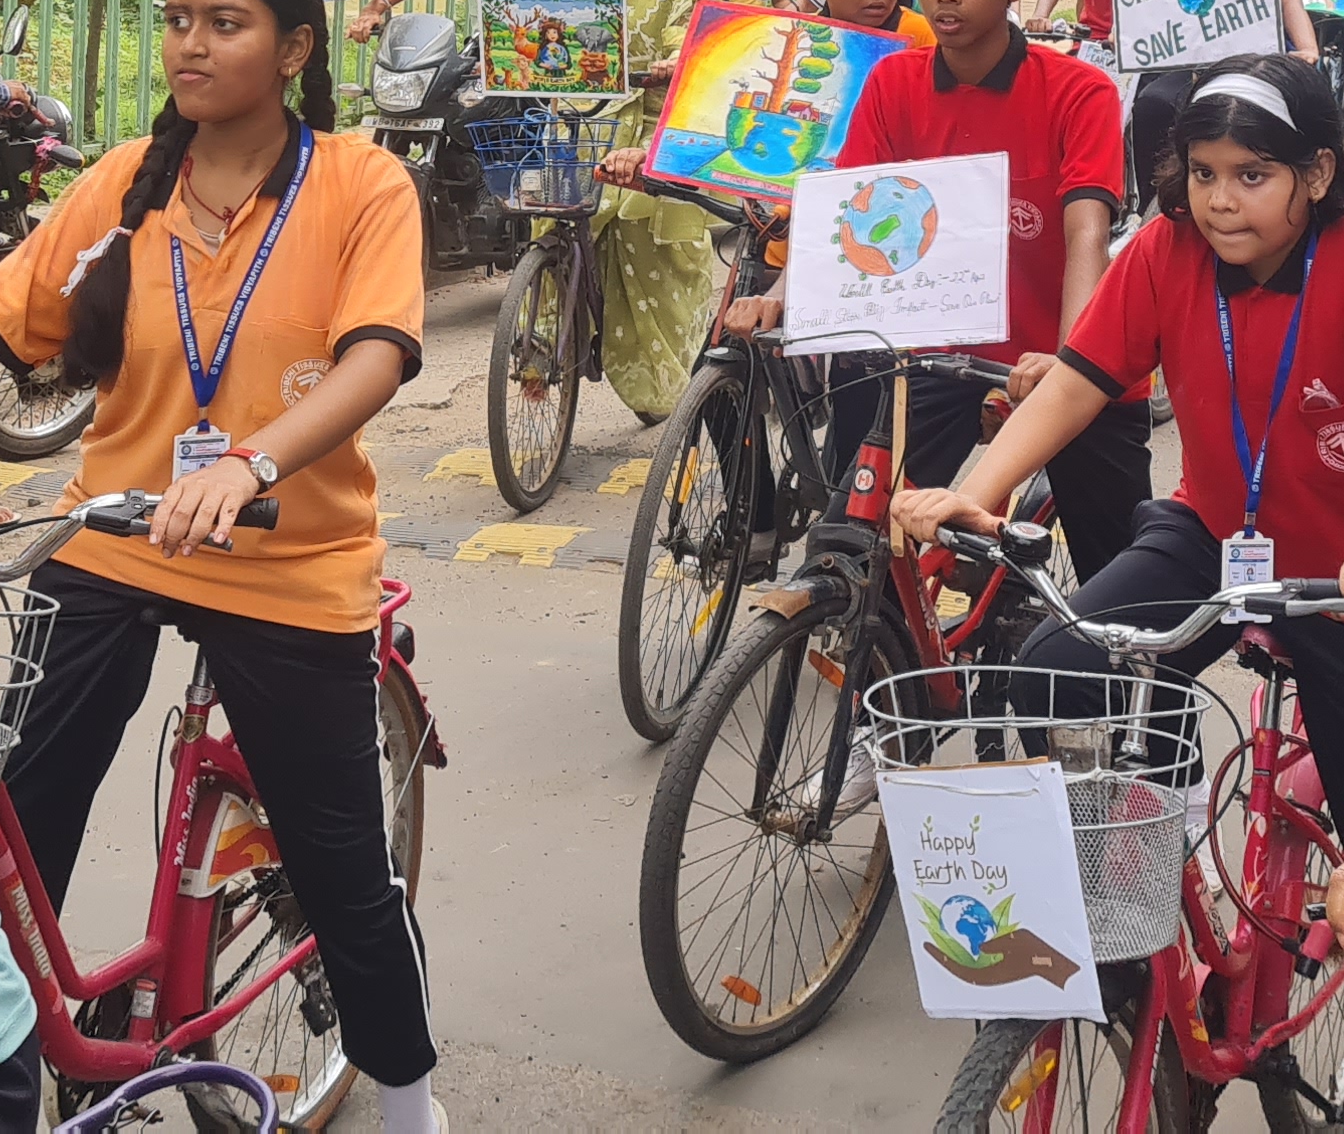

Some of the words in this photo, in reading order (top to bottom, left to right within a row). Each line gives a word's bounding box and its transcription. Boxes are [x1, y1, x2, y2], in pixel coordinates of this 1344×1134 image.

[1133, 19, 1187, 66] SAVE
[212, 333, 232, 367] TRIBENI
[225, 300, 246, 334] TISSUES
[239, 258, 265, 300] VIDYAPITH
[920, 830, 976, 856] Happy
[913, 860, 967, 884] Earth
[971, 860, 1008, 890] Day
